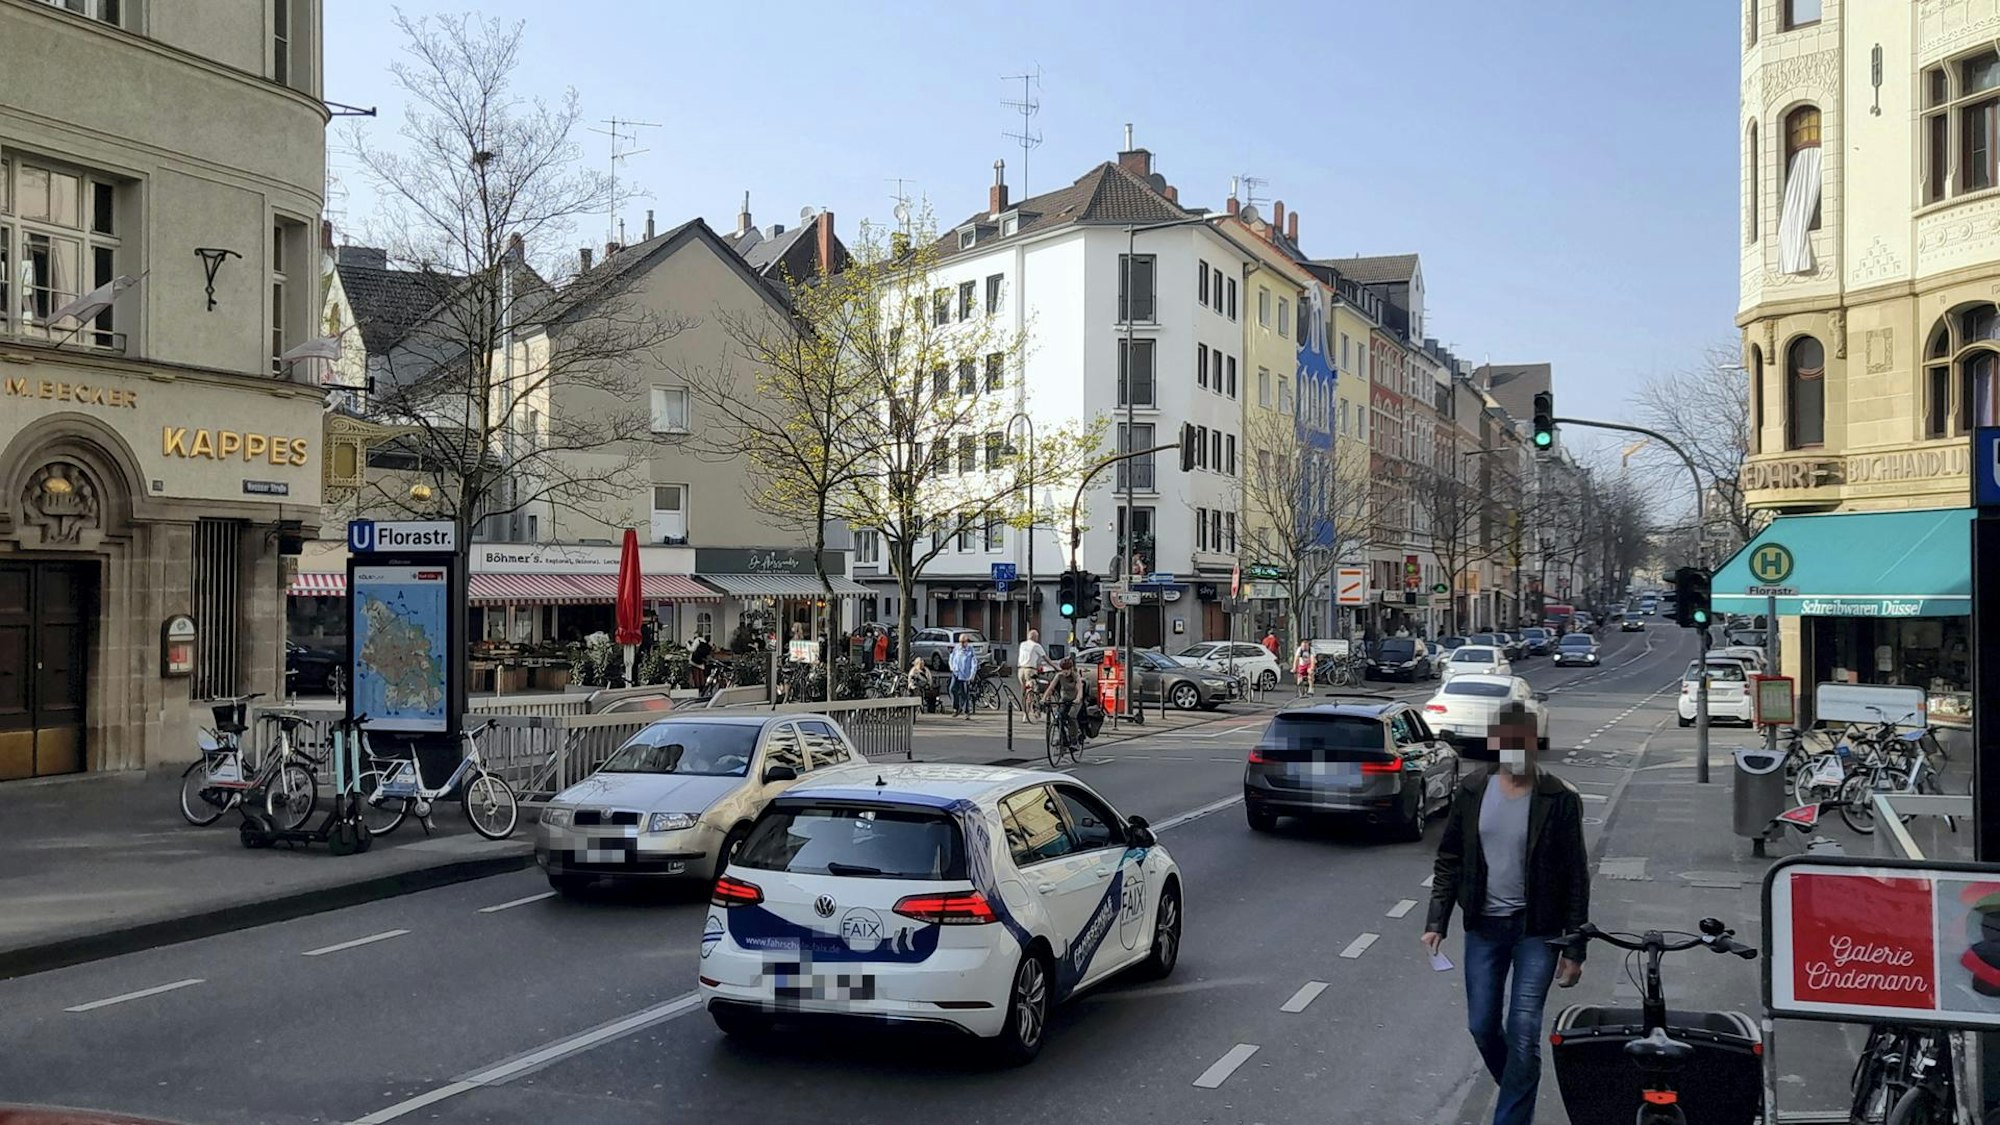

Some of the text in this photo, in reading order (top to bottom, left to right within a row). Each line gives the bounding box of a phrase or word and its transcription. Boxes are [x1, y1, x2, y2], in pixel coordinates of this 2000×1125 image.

[5, 378, 137, 409] M. BECKER
[163, 426, 308, 466] KAPPES
[353, 525, 451, 549] U Florastr.
[1761, 552, 1782, 574] H
[1200, 586, 1214, 595] sky
[1801, 600, 1923, 616] Schreibwaren Düssel
[1121, 885, 1145, 921] FAIX
[842, 922, 880, 938] FAIX
[1829, 934, 1914, 968] Galerie
